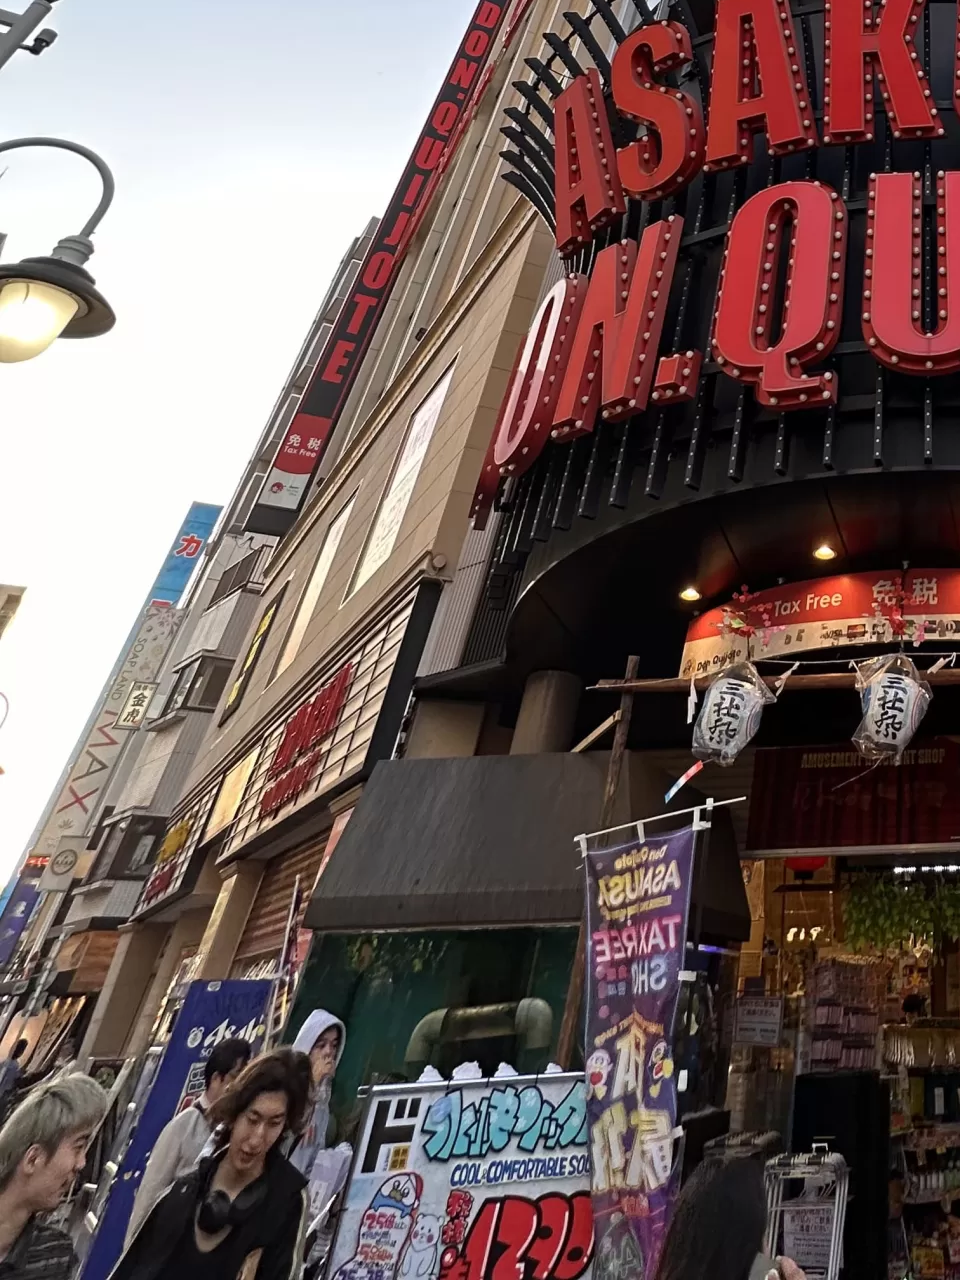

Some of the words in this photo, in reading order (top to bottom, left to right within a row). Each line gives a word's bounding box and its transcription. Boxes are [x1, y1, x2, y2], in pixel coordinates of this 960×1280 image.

[321, 0, 500, 384] DON.QUIJOTE
[283, 445, 297, 455] Tax
[298, 448, 317, 458] Free
[286, 433, 323, 451] 免税
[774, 599, 801, 617] Tax
[805, 592, 843, 611] Free
[871, 577, 939, 607] 免税
[800, 751, 862, 768] AMUSEMENT
[917, 748, 945, 765] SHOP
[361, 1097, 422, 1173] ド
[450, 1161, 481, 1187] COOL
[486, 1158, 567, 1183] COMFORTABLE
